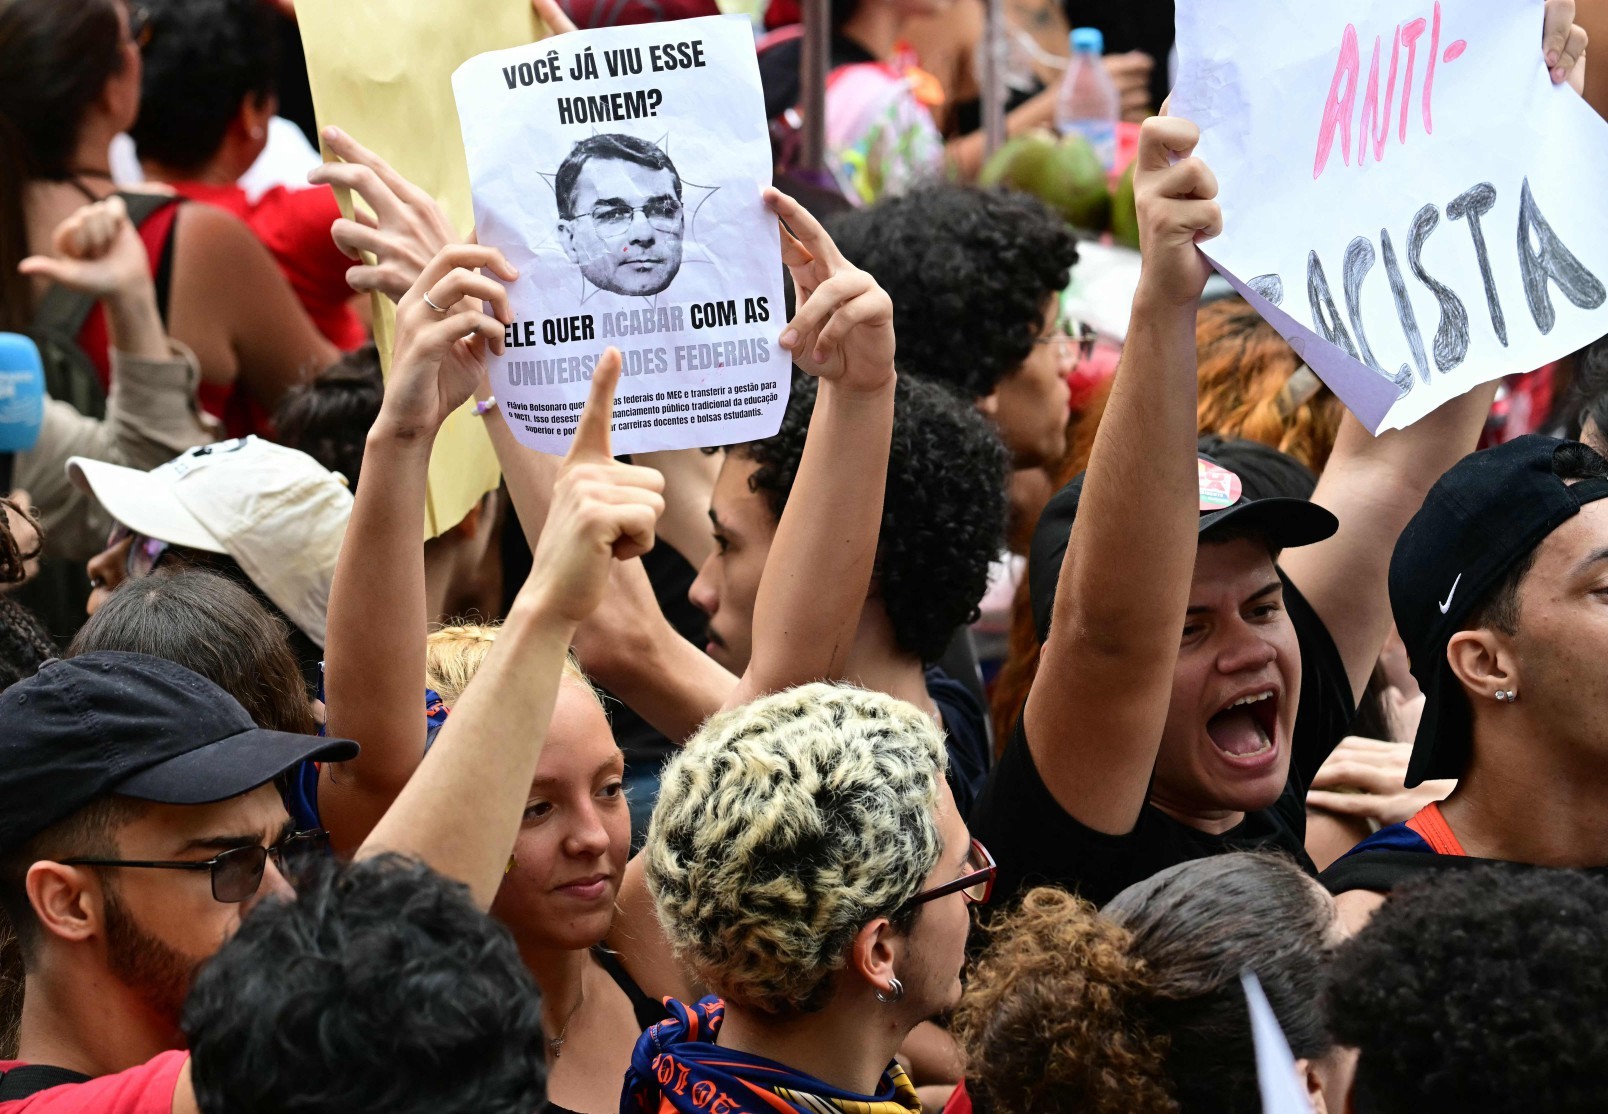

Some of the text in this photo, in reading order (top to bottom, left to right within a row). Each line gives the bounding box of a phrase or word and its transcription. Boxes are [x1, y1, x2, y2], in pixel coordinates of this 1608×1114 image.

[502, 40, 706, 89] VOCÊ JÁ VIU ESSE
[557, 88, 663, 125] HOMEM?
[1313, 0, 1467, 179] ANTI-
[1244, 174, 1607, 400] ACISTA
[505, 296, 770, 348] ELE QUER ACABAR COM AS
[508, 337, 771, 387] UNIVERSADES FEDERAIS
[507, 401, 528, 411] Flávio
[529, 402, 567, 411] Bolsonaro
[569, 401, 585, 411] quer
[623, 392, 653, 404] federais
[655, 392, 665, 401] do
[666, 390, 682, 400] MEC
[684, 390, 689, 398] e
[691, 386, 725, 398] transferir
[727, 386, 732, 394] a
[734, 382, 759, 394] gestão
[760, 381, 777, 391] para
[533, 415, 549, 423] Isso
[550, 414, 581, 423] desestr
[611, 404, 660, 418] nanciamento
[661, 403, 690, 414] público
[691, 398, 731, 410] tradicional
[733, 397, 742, 406] da
[743, 392, 778, 405] educação
[525, 425, 554, 434] superior
[556, 427, 561, 435] e
[618, 419, 652, 431] carreiras
[653, 416, 689, 427] docentes
[697, 413, 722, 423] bolsas
[723, 408, 763, 420] estudantis.
